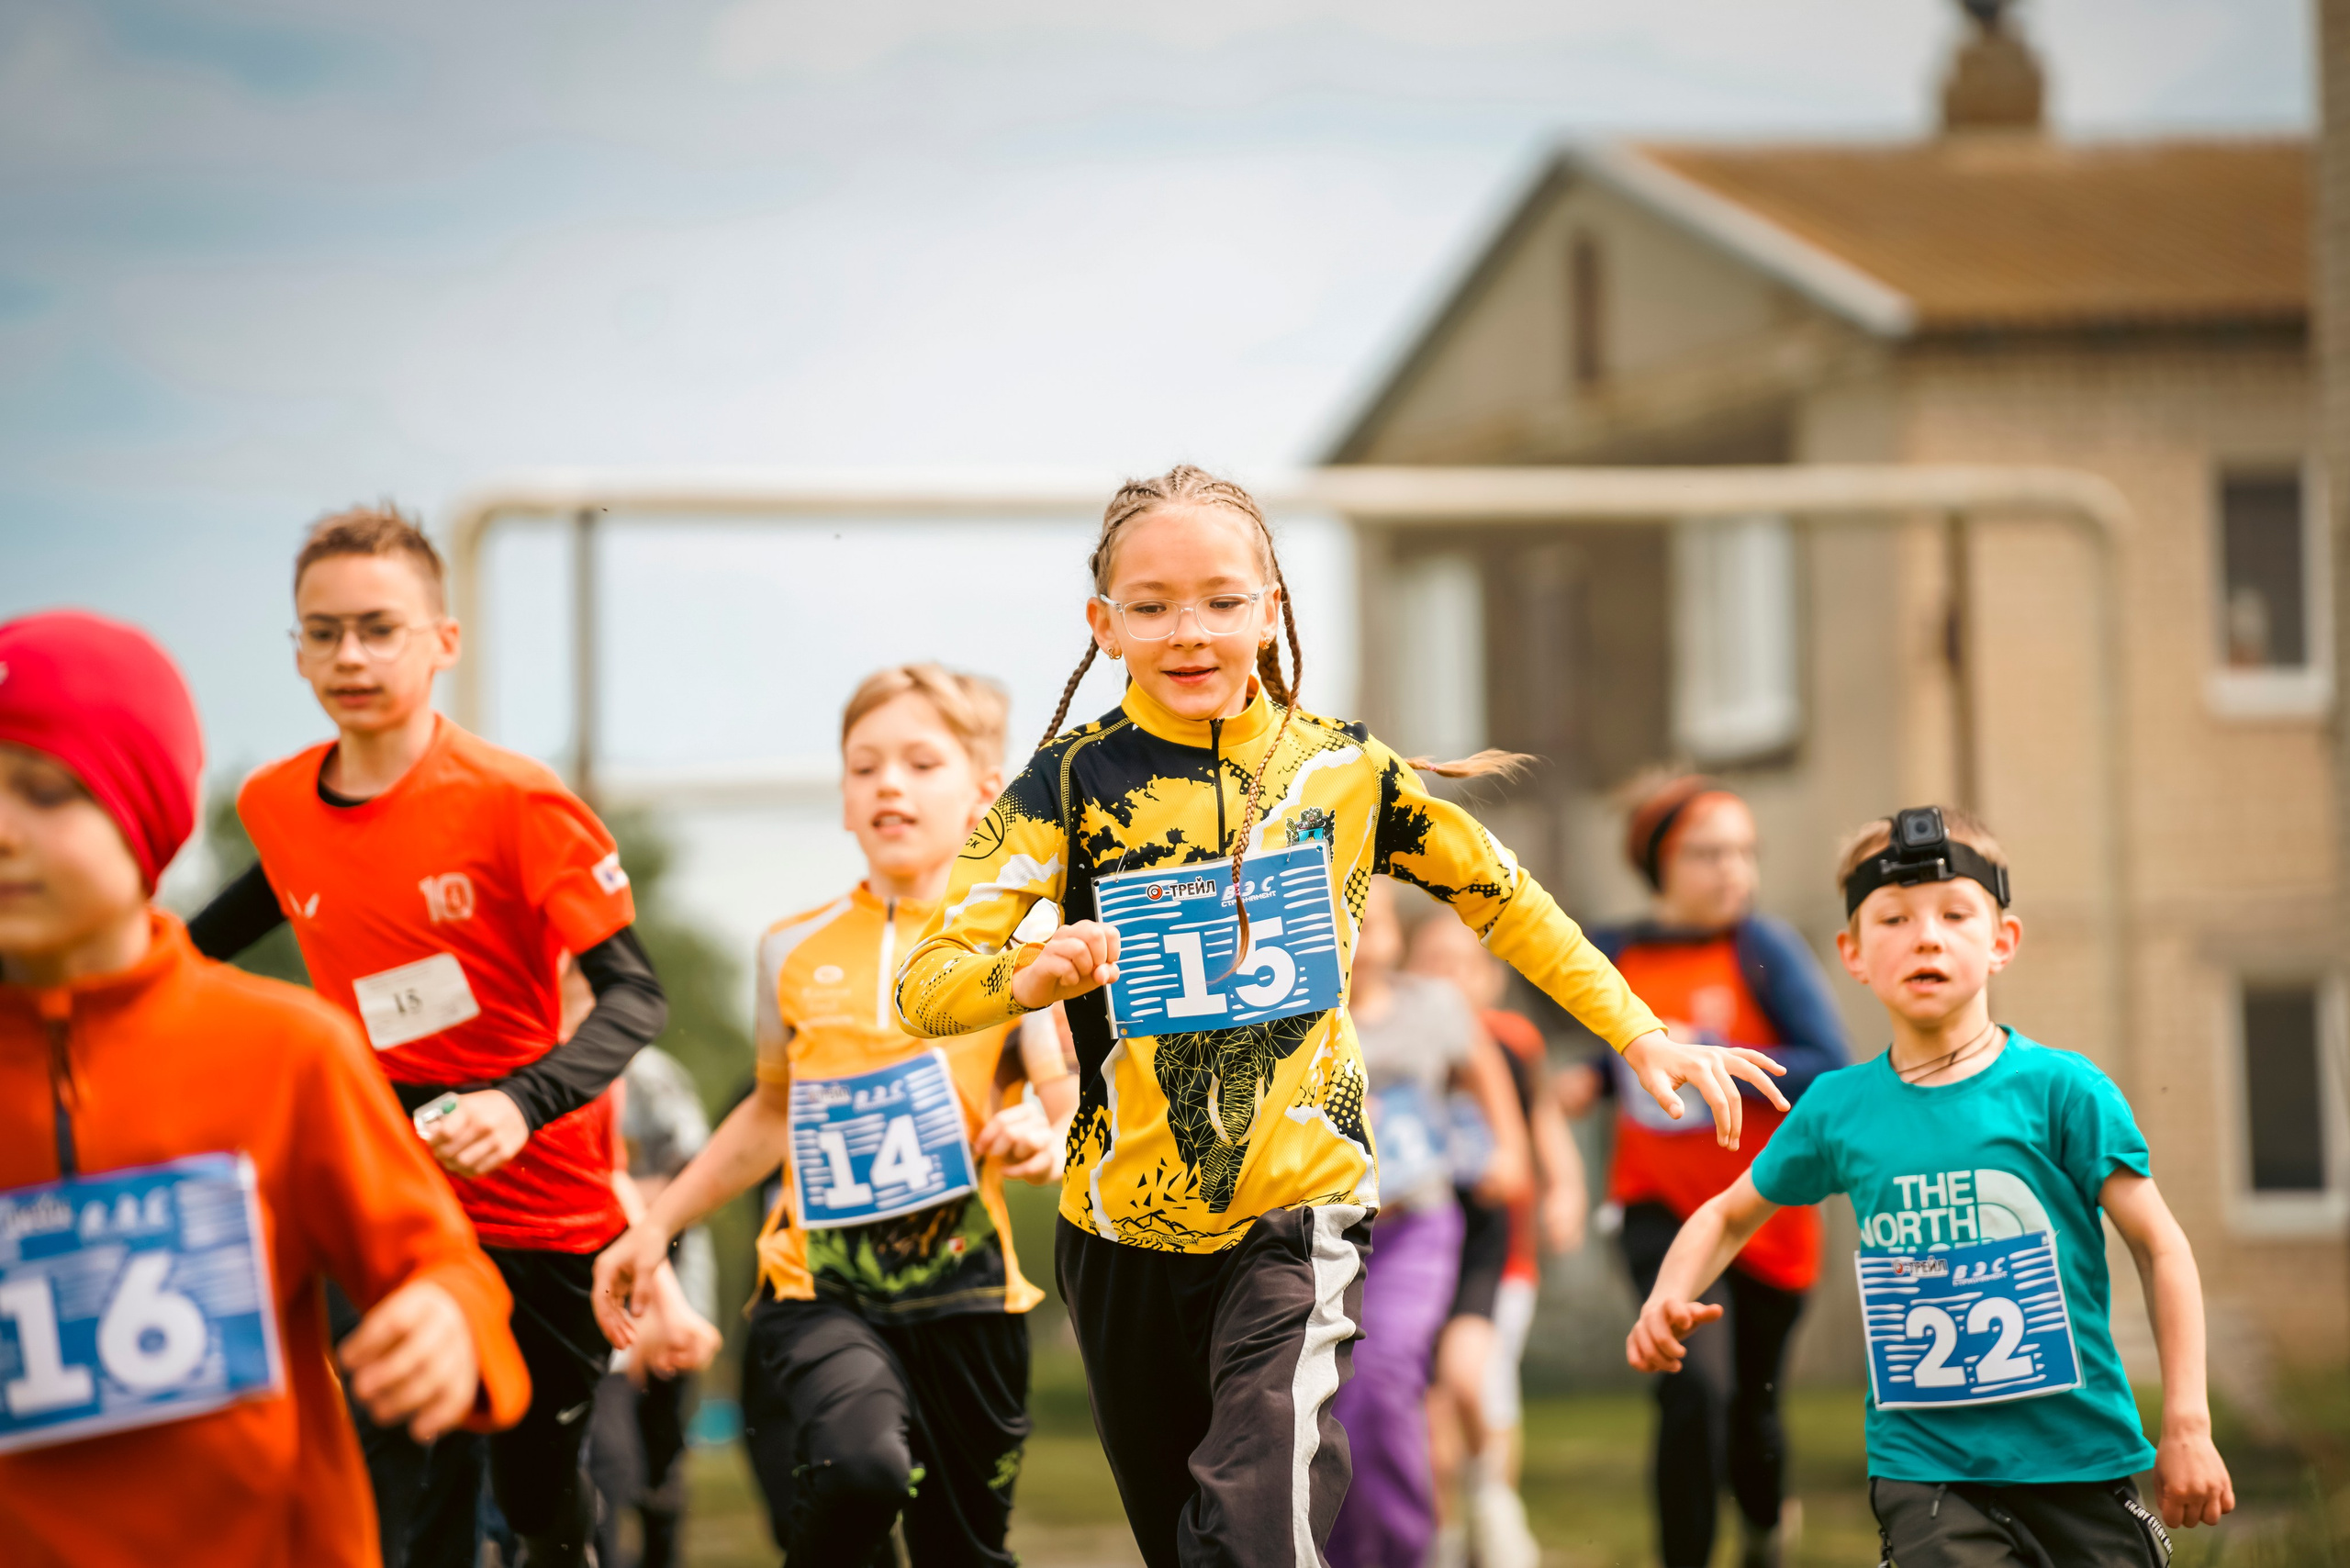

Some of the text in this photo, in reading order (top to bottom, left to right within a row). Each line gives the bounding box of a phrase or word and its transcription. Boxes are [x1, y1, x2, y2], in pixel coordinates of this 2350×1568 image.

[394, 988, 422, 1016] 15
[1163, 916, 1295, 1018] 15
[818, 1114, 933, 1209] 14
[1893, 1170, 1974, 1209] THE
[0, 1251, 206, 1418] 16
[1906, 1297, 2033, 1388] 22
[2124, 1500, 2151, 1520] ENJOY
[2148, 1516, 2166, 1540] EVERY
